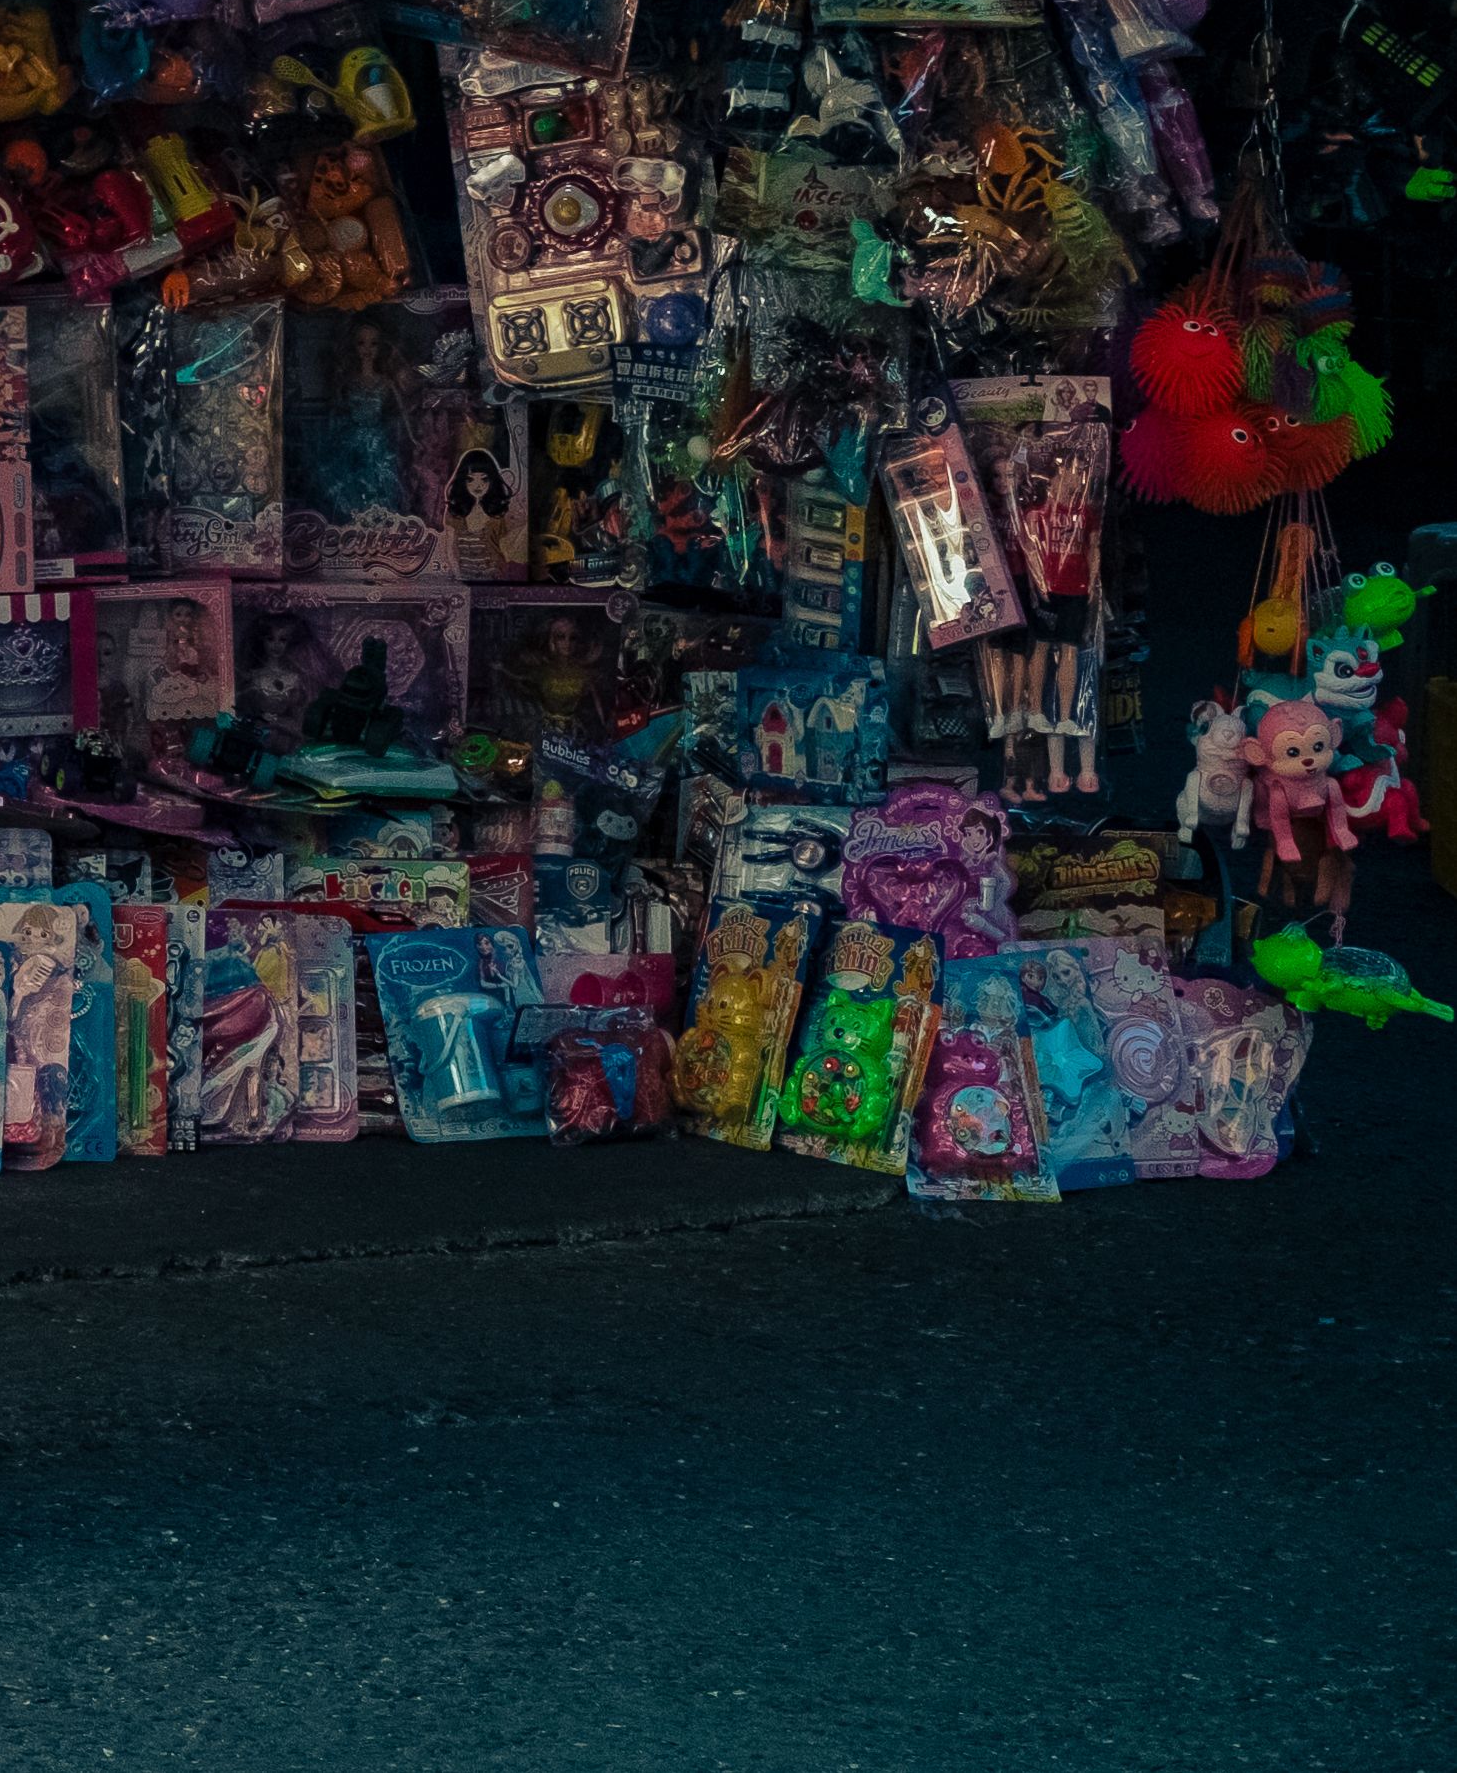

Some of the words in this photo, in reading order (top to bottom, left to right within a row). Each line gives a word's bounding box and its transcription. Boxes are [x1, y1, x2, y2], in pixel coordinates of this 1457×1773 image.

[955, 381, 1011, 400] Beauty
[541, 738, 591, 766] Bubbles
[851, 819, 941, 853] Princess
[569, 869, 597, 878] POLICE
[390, 955, 455, 975] FROZEN
